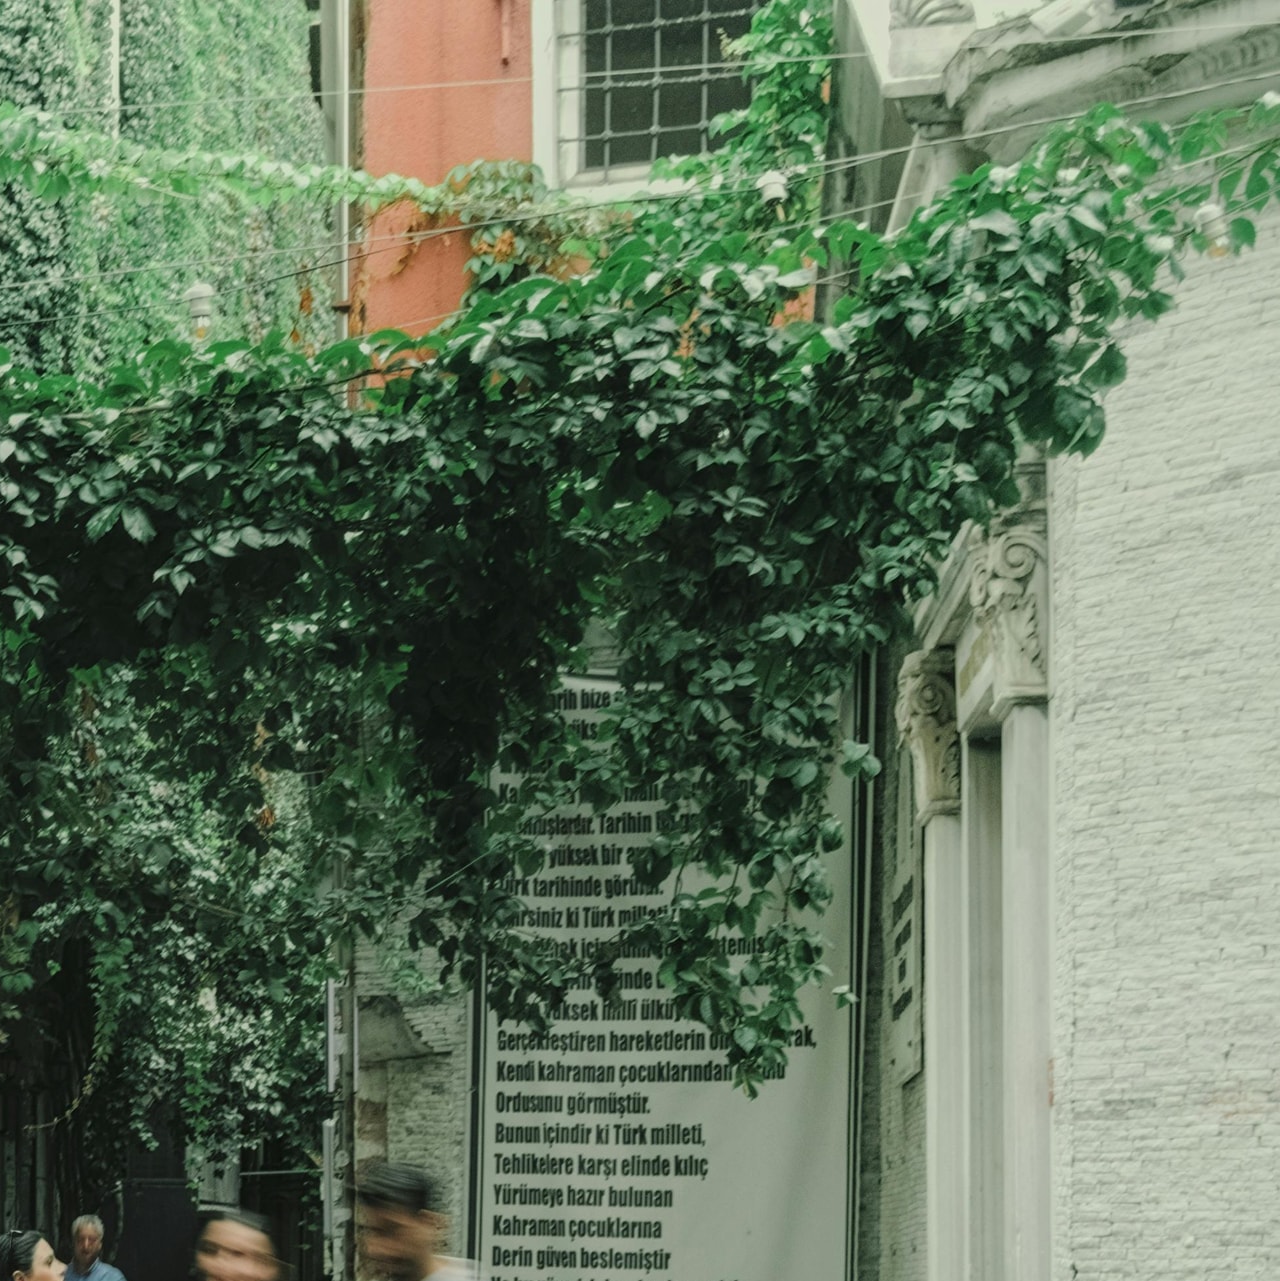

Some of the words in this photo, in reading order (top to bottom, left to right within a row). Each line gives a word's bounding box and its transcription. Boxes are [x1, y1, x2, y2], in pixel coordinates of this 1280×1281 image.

[600, 811, 652, 834] Tarihin
[549, 844, 600, 868] yüksek
[601, 844, 623, 866] bir
[533, 875, 602, 897] tarihinde
[565, 907, 580, 928] ki
[583, 906, 616, 928] Türk
[610, 1029, 705, 1052] hareketlerin
[497, 1061, 535, 1082] Kendi
[538, 1061, 615, 1083] kahraman
[619, 1061, 732, 1086] çocuklarından
[496, 1091, 563, 1113] Ordusunu
[567, 1092, 651, 1118] görmüştür.
[495, 1123, 541, 1144] Bunun
[543, 1122, 592, 1148] içindir
[596, 1123, 610, 1145] ki
[614, 1123, 648, 1146] Türk
[651, 1123, 707, 1148] milleti,
[495, 1153, 573, 1176] Tehlikelere
[577, 1153, 618, 1181] karşı
[621, 1154, 671, 1177] elinde
[675, 1155, 709, 1181] kılıç
[493, 1184, 564, 1210] Yürümeye
[567, 1185, 606, 1207] hazır
[609, 1186, 673, 1208] bulunan
[493, 1215, 566, 1238] Kahraman
[569, 1216, 662, 1242] çocuklarına
[492, 1246, 533, 1267] Derin
[536, 1246, 577, 1270] güven
[580, 1248, 671, 1274] beslemiştir
